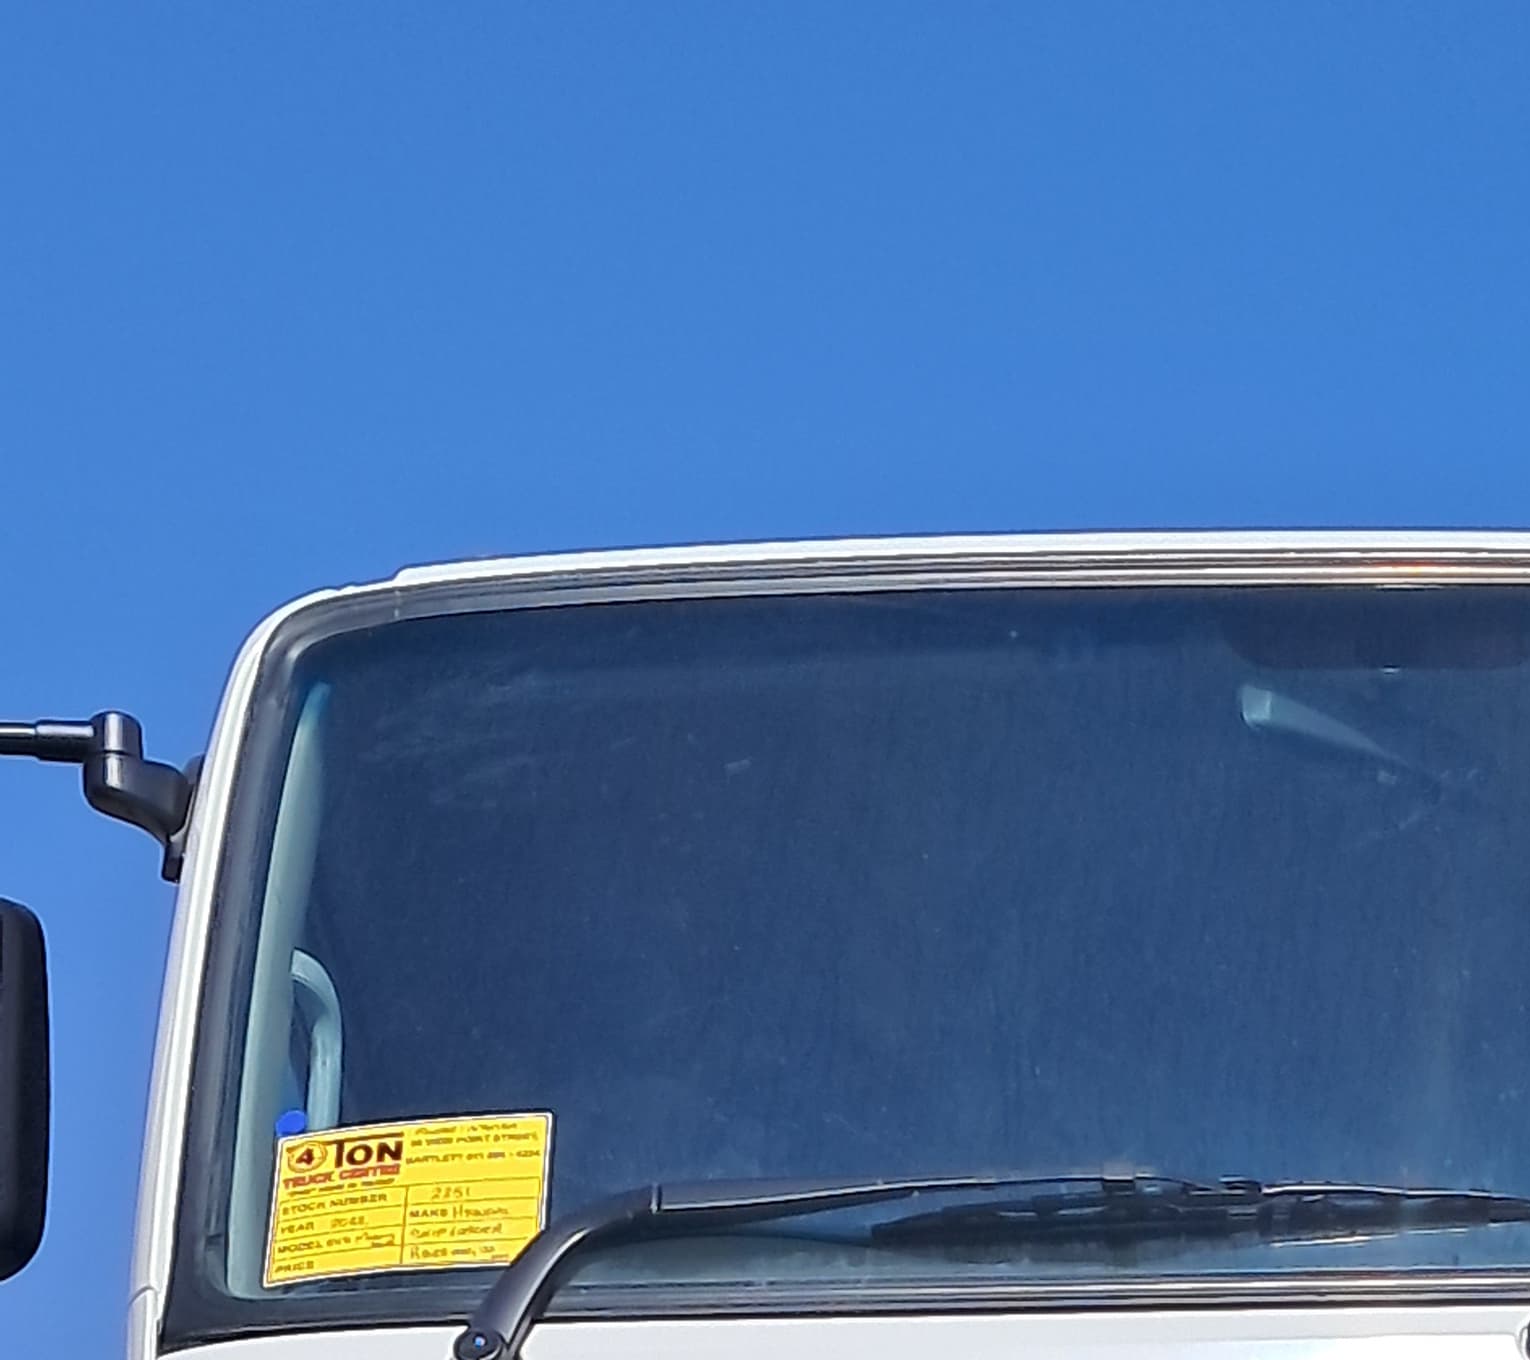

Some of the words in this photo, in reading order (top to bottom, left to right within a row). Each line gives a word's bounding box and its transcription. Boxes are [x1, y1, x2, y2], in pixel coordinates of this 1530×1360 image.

[296, 1147, 315, 1166] 4
[324, 1132, 404, 1169] TON
[281, 1221, 315, 1234] YEAR
